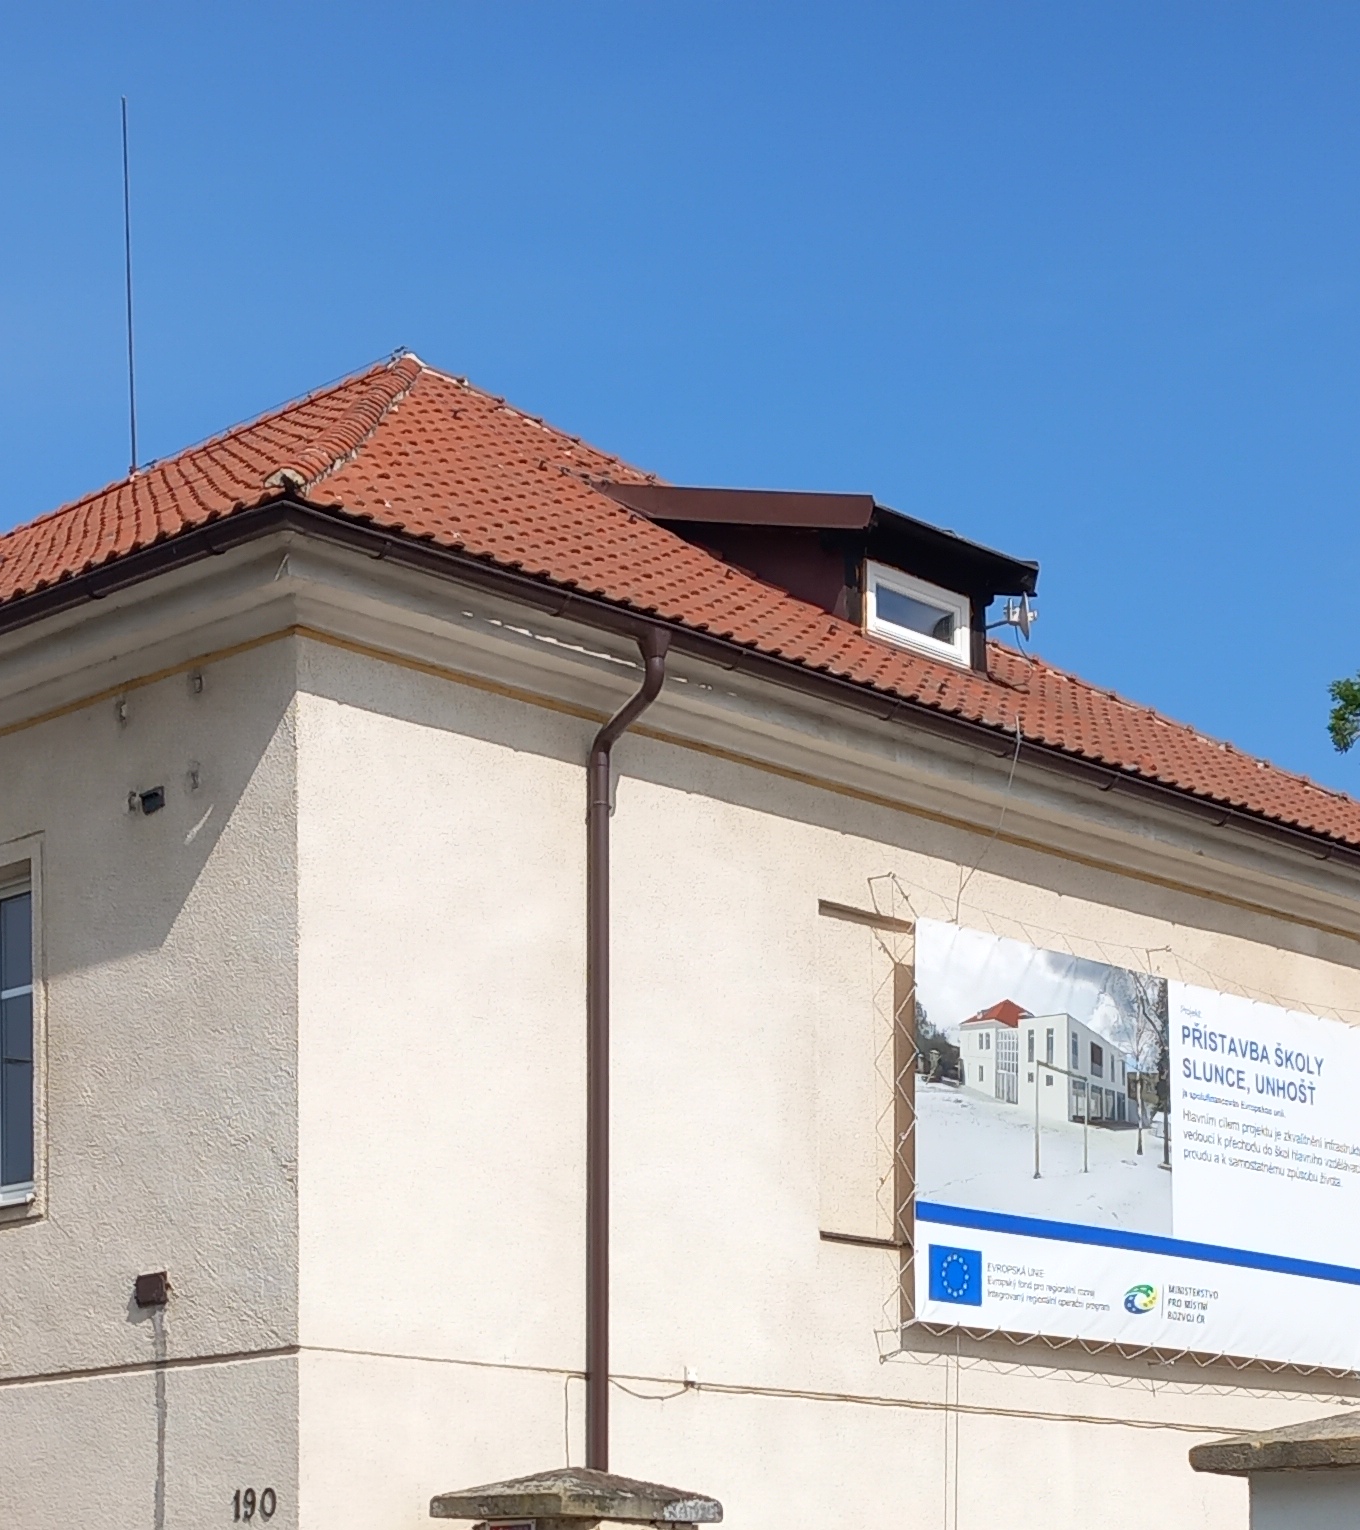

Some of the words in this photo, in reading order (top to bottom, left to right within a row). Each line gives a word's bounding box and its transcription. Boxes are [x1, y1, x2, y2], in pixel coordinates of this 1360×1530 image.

[1181, 1022, 1270, 1065] PŘÍSTAVBA
[1274, 1042, 1324, 1077] ŠKOLY
[1182, 1057, 1251, 1095] SLUNCE,
[1255, 1073, 1316, 1106] UNHOŠŤ
[1242, 1122, 1273, 1139] projektu
[1274, 1127, 1282, 1142] je
[1217, 1133, 1222, 1145] k
[1224, 1135, 1261, 1153] přechodu
[1262, 1143, 1273, 1156] do
[1183, 1148, 1212, 1162] proudu
[1214, 1153, 1220, 1164] a
[1221, 1152, 1227, 1164] k
[987, 1262, 1027, 1276] EVROPSKÁ
[1167, 1297, 1182, 1308] PRO
[232, 1487, 277, 1521] 190
